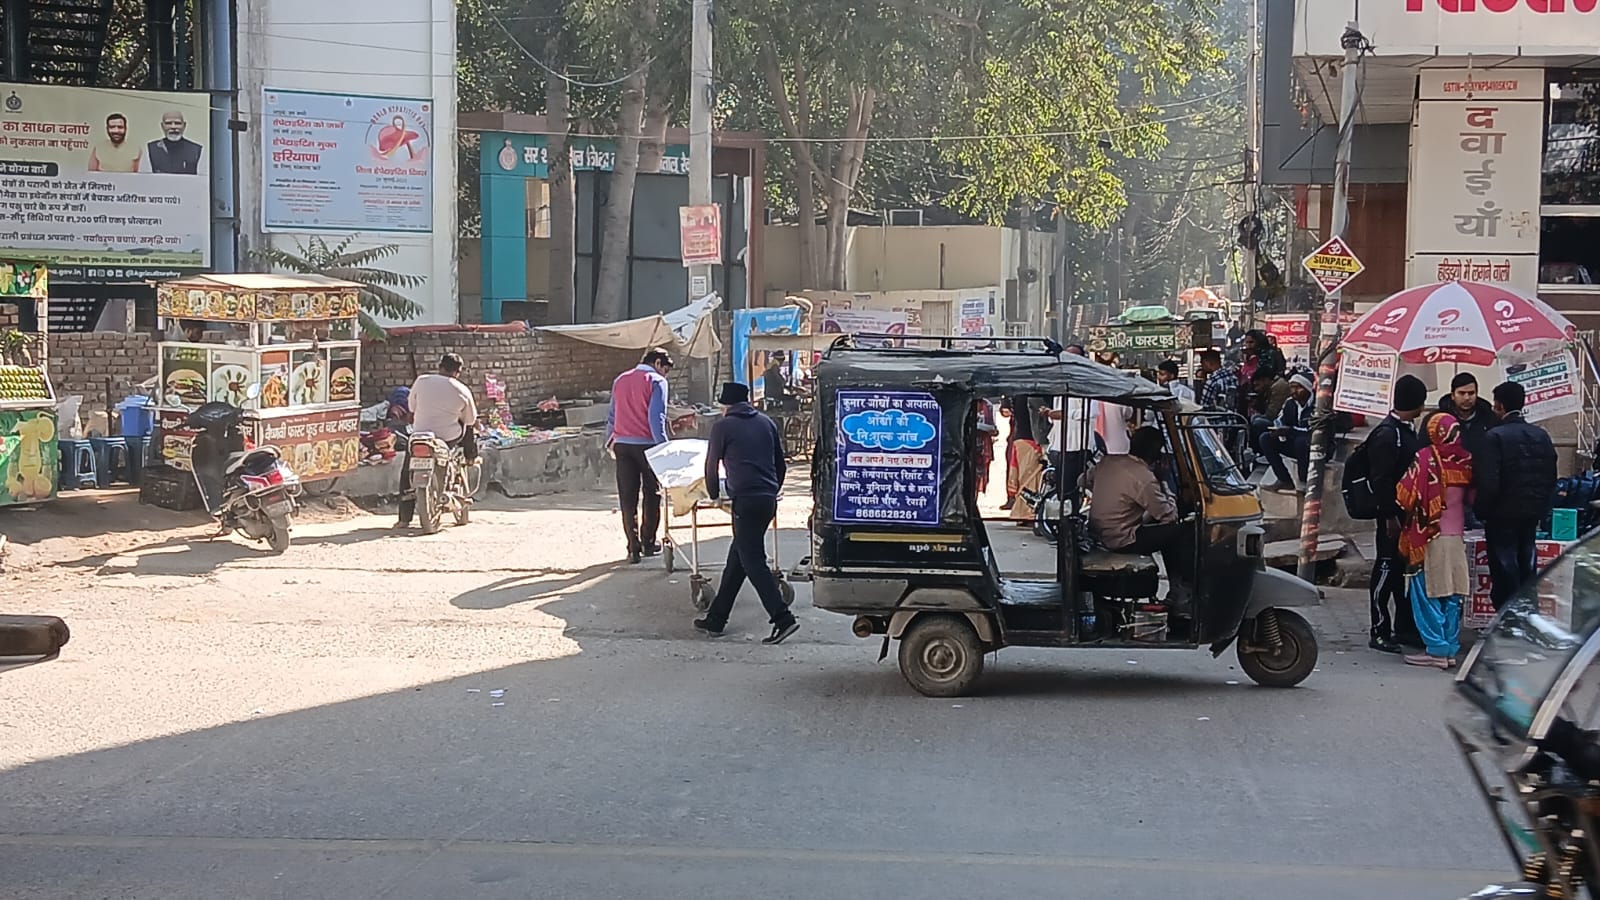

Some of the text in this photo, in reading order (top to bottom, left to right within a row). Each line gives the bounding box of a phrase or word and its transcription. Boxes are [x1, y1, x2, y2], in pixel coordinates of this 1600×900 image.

[272, 149, 319, 163] हरियाणा
[1313, 256, 1353, 267] SUNPACK
[1463, 258, 1472, 281] में
[1493, 259, 1511, 281] वाली
[1495, 316, 1533, 327] Payments
[1425, 326, 1471, 334] Payments
[1135, 335, 1158, 347] फास्ट
[842, 398, 866, 411] कुमार
[892, 398, 904, 409] का
[905, 400, 938, 410] अस्पताल
[896, 415, 909, 426] की
[287, 425, 305, 438] फास्ट
